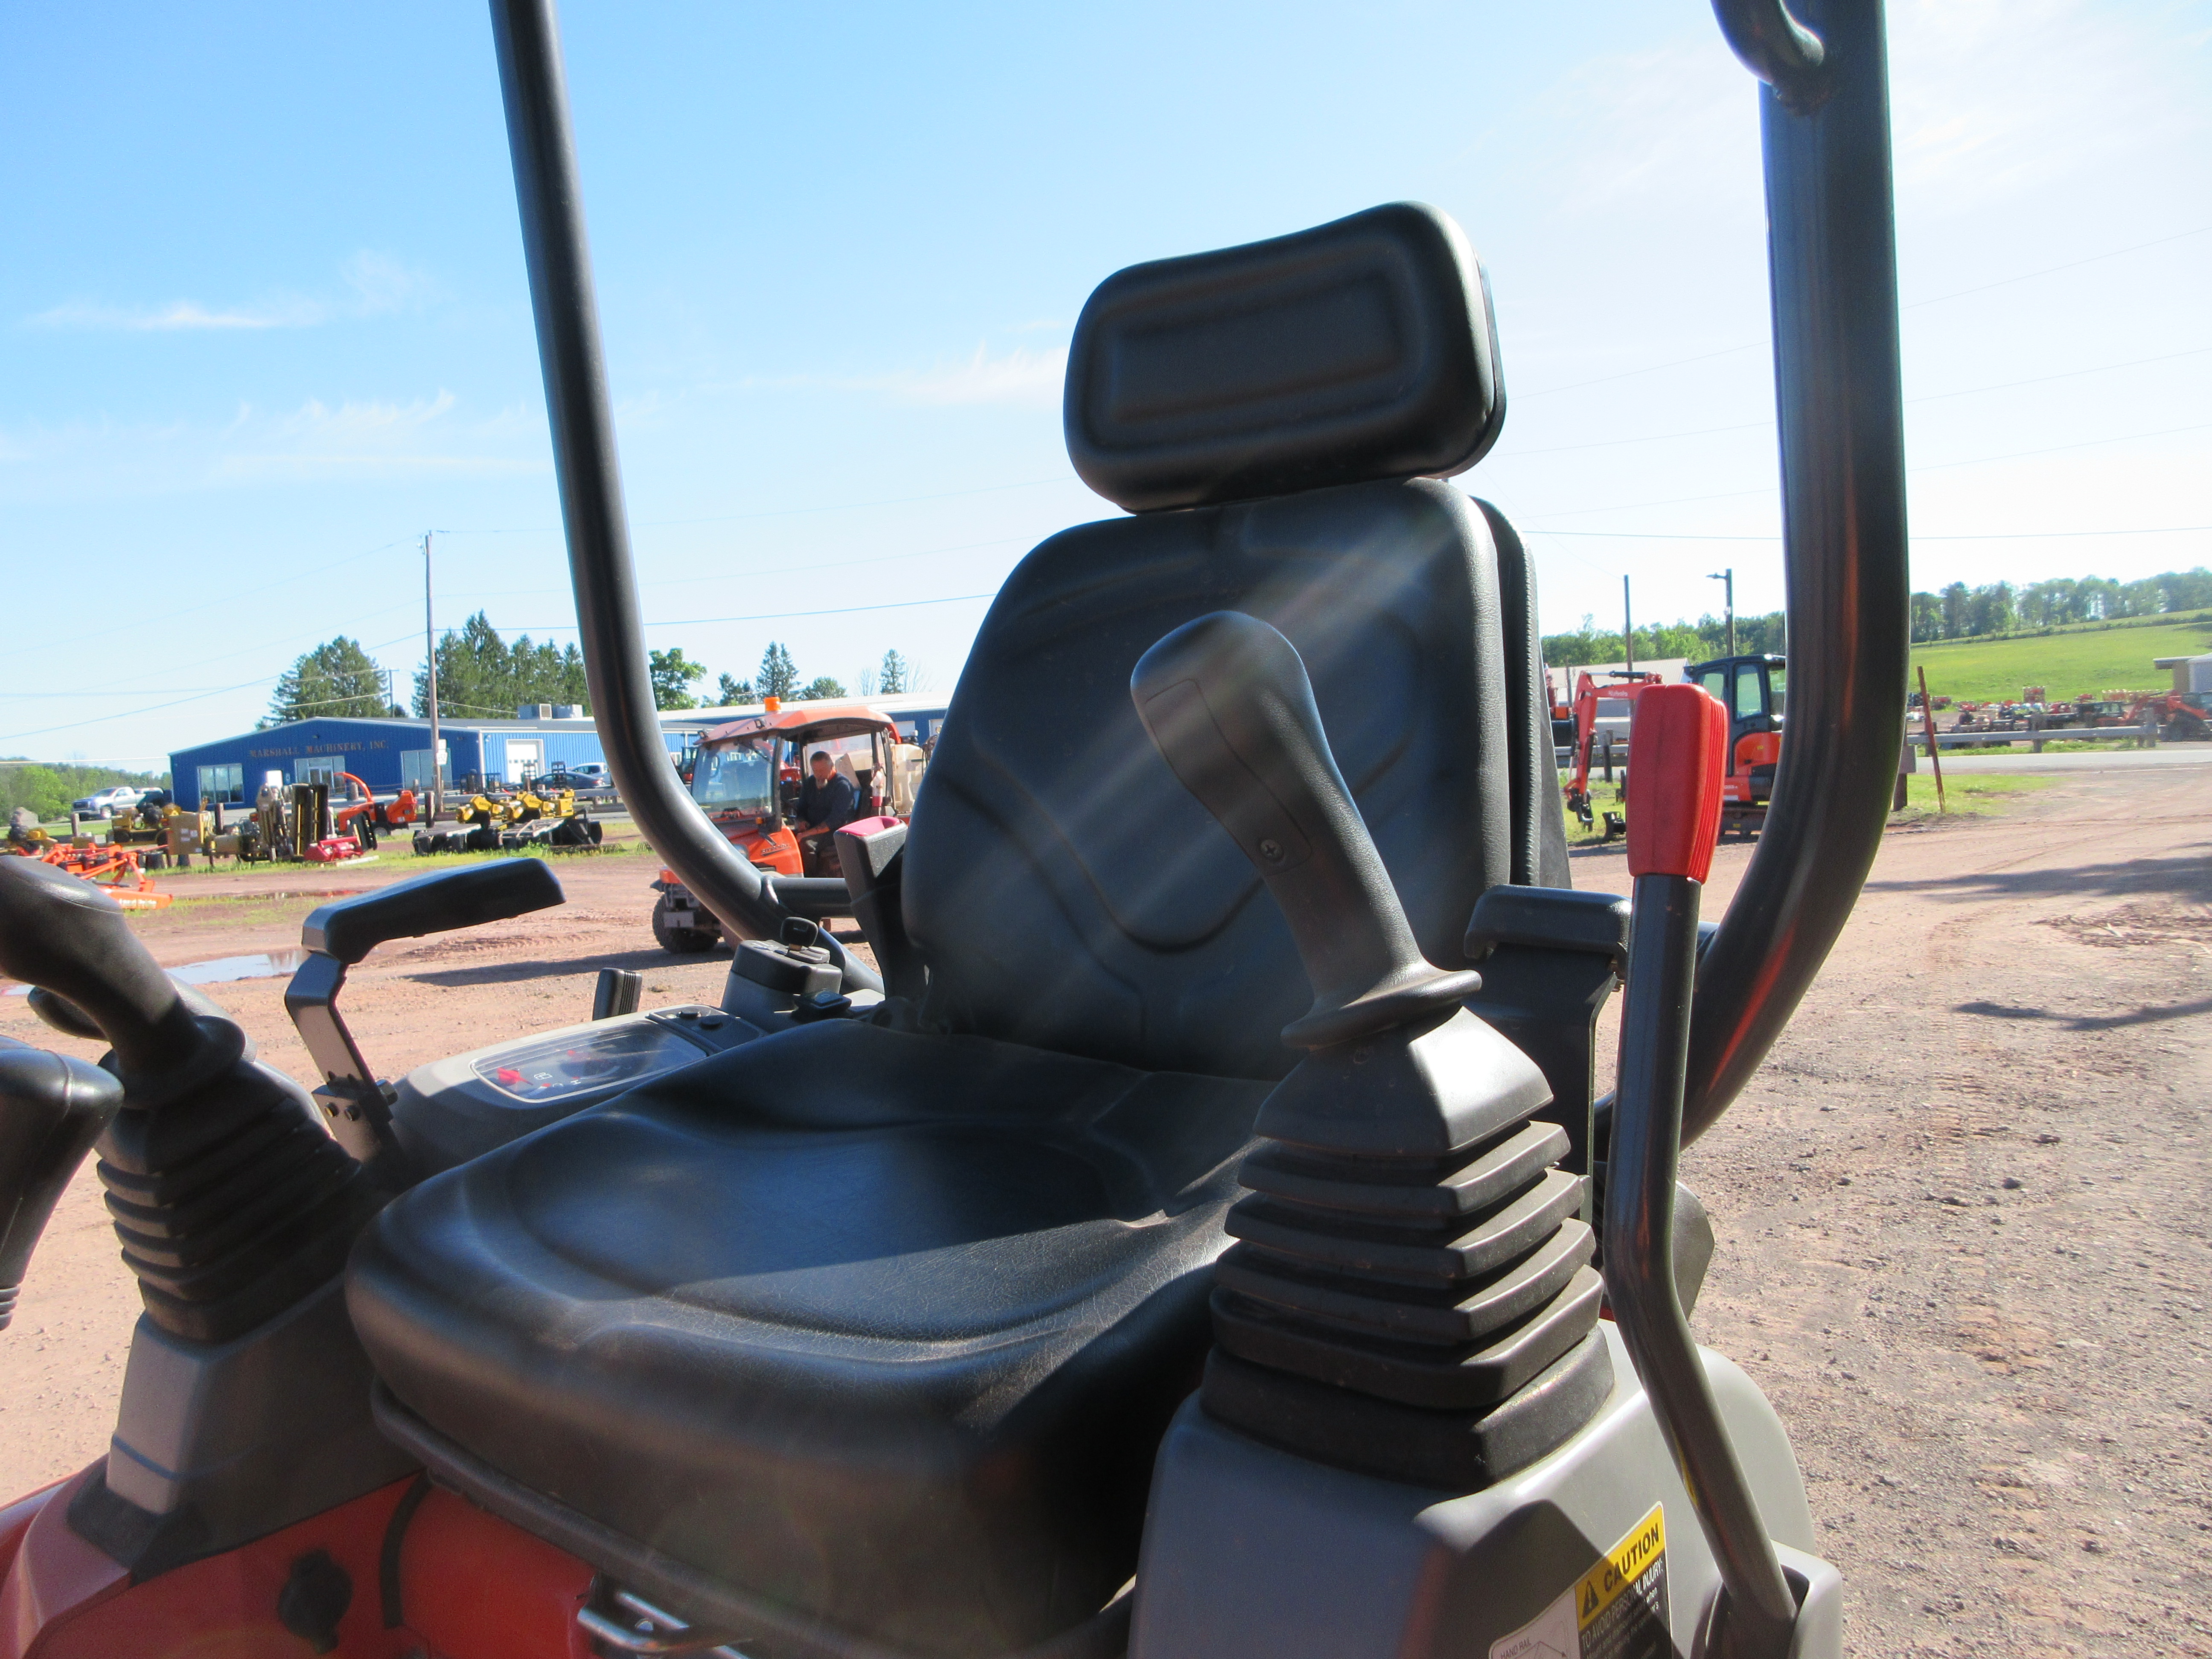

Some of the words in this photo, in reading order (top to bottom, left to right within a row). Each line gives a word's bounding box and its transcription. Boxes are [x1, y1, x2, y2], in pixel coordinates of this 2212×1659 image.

[370, 740, 389, 749] INC.
[1604, 1522, 1659, 1592] CAUTION
[1582, 1630, 1591, 1652] TO
[1592, 1611, 1611, 1643] AVOID
[1611, 1579, 1643, 1621] PERSONAL
[1643, 1557, 1663, 1590] INJURY:
